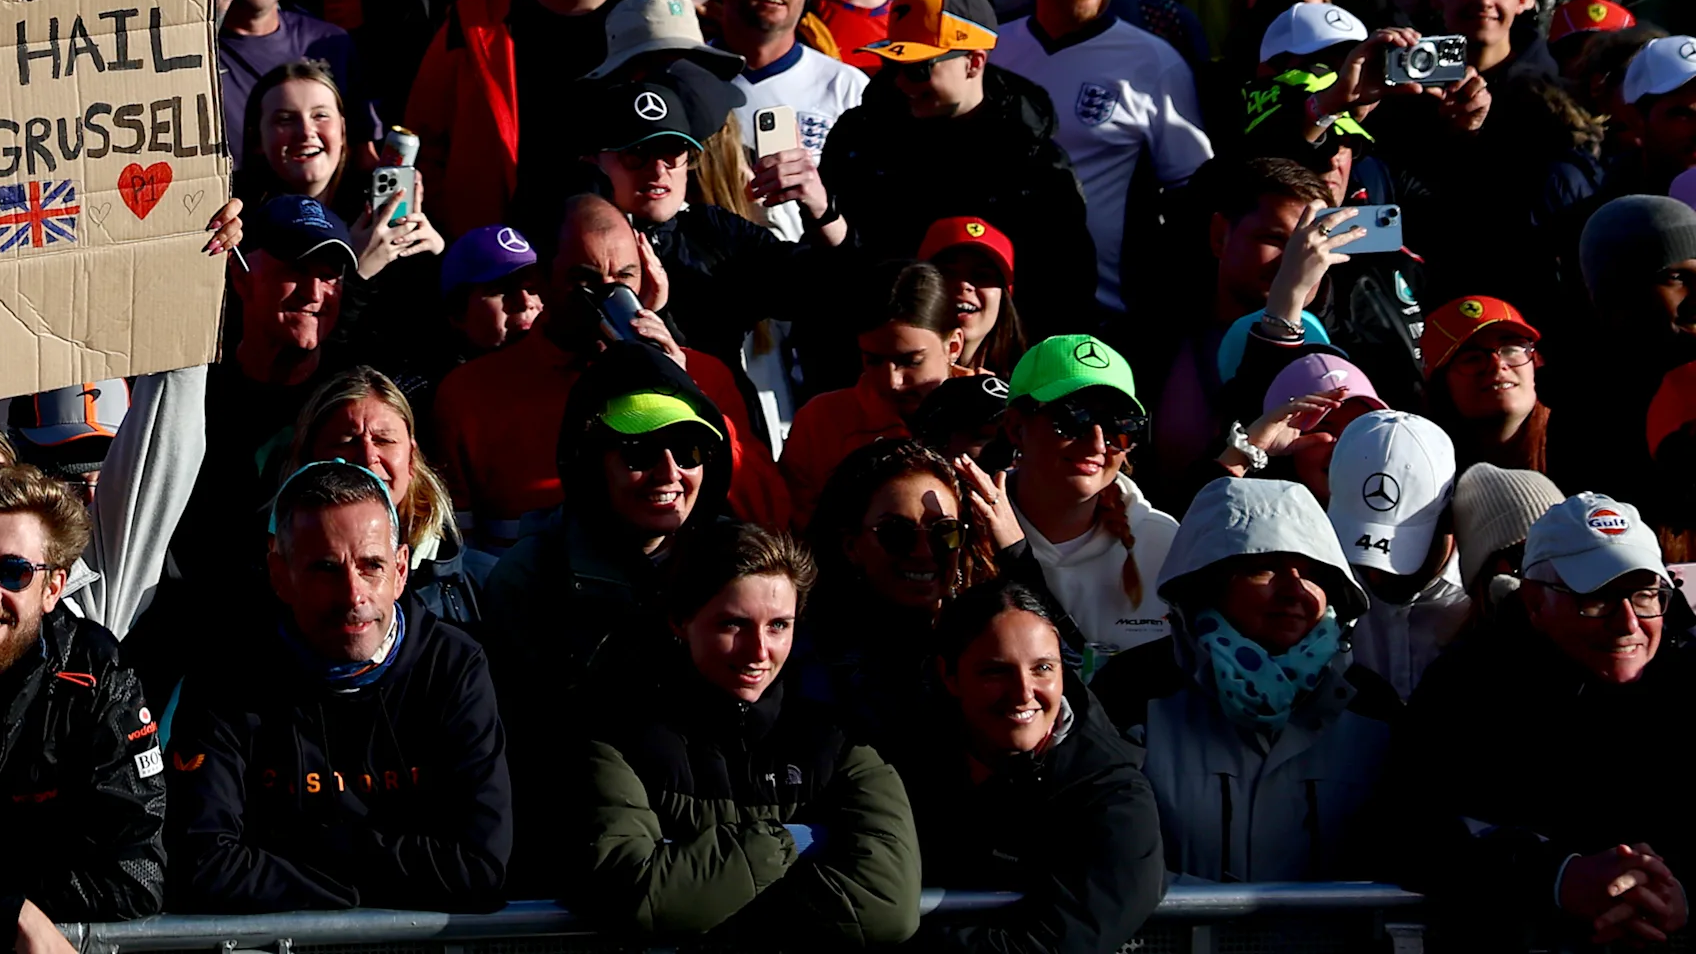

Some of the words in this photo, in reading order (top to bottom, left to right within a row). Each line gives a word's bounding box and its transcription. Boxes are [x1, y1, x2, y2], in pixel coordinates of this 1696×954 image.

[17, 7, 203, 86] HAIL
[131, 174, 157, 204] P1
[1588, 517, 1628, 529] Gulf
[1355, 534, 1391, 555] 44
